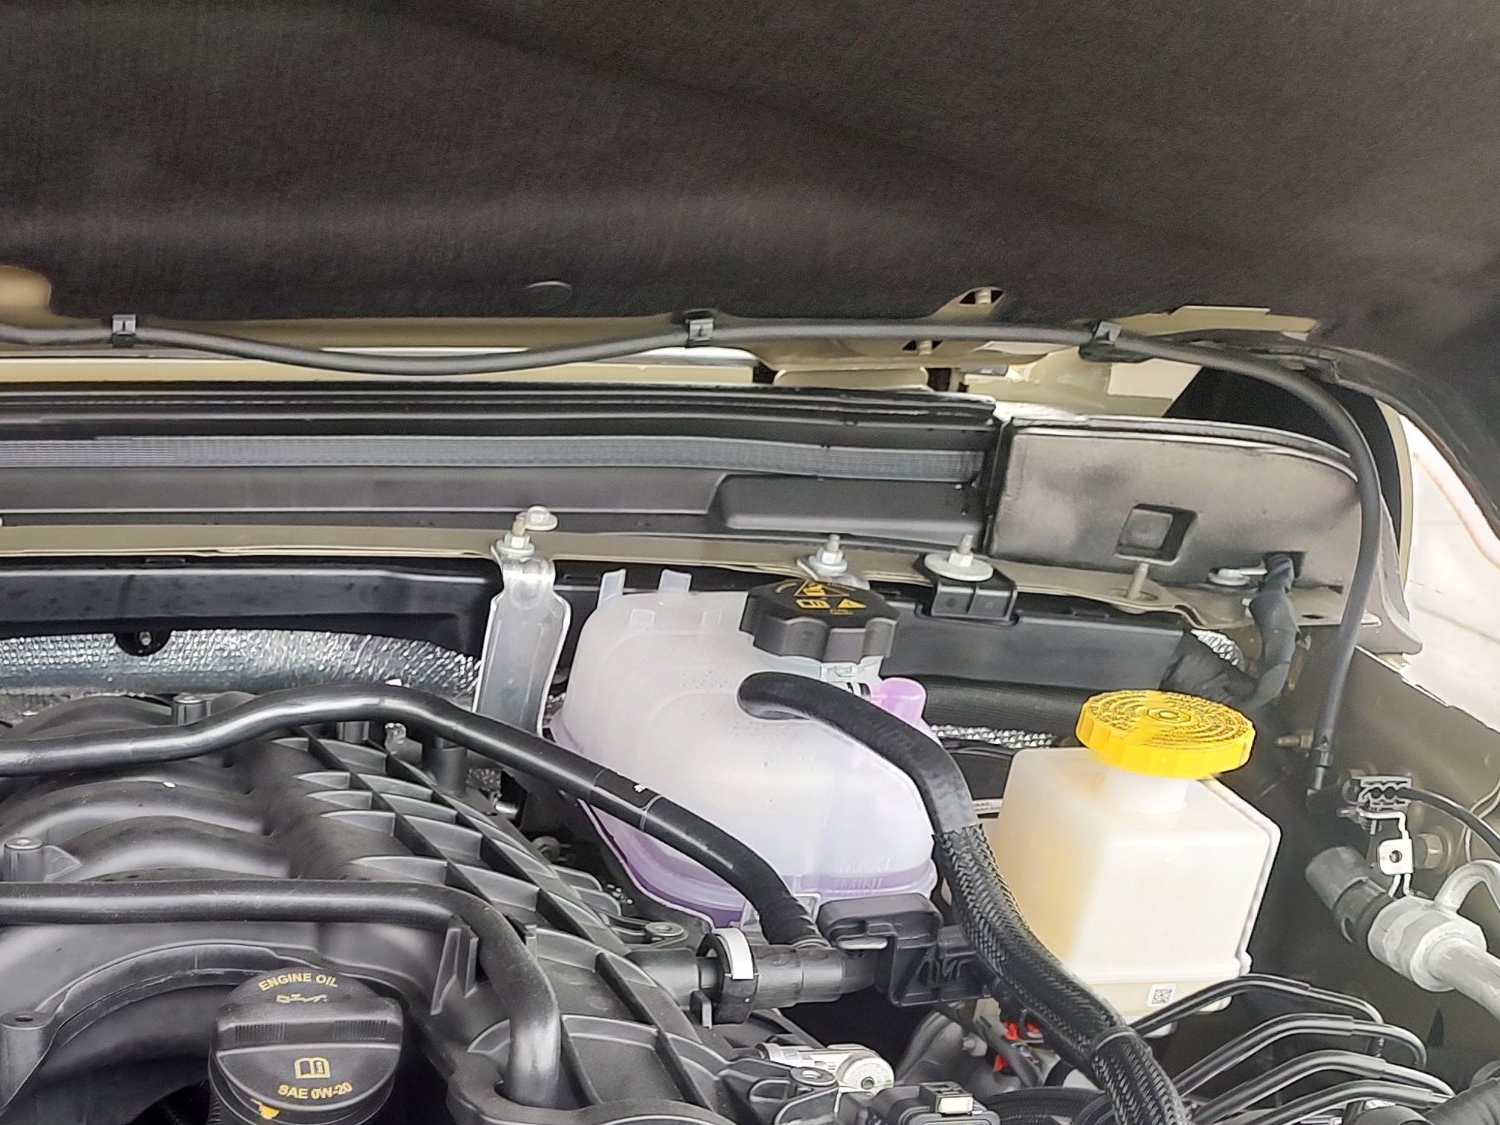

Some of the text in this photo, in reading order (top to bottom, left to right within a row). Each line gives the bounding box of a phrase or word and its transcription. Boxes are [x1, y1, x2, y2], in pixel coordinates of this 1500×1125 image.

[259, 973, 339, 992] ENGINE OIL
[278, 1081, 353, 1099] SAE 0W-20
